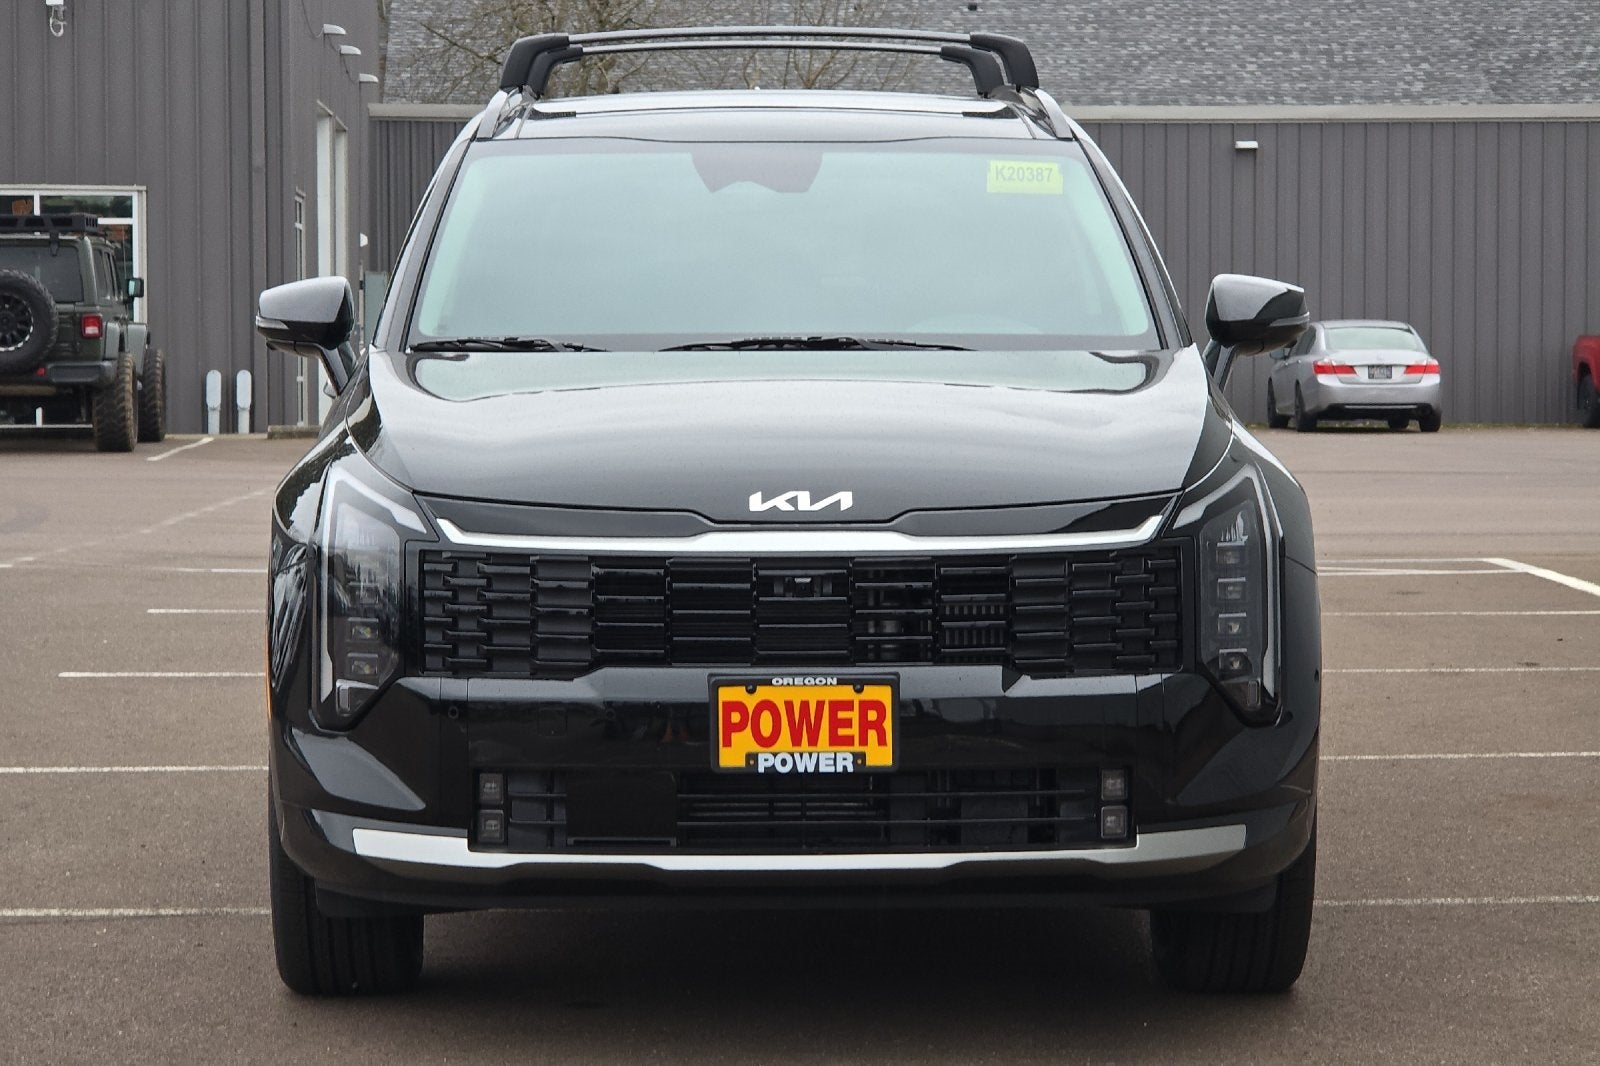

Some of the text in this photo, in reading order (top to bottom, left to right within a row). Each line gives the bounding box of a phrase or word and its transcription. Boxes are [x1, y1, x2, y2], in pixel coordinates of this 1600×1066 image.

[995, 165, 1053, 182] K20387
[749, 491, 853, 511] KIA
[771, 677, 838, 686] OREGON
[722, 699, 888, 748] POWER
[757, 752, 854, 773] POWER
